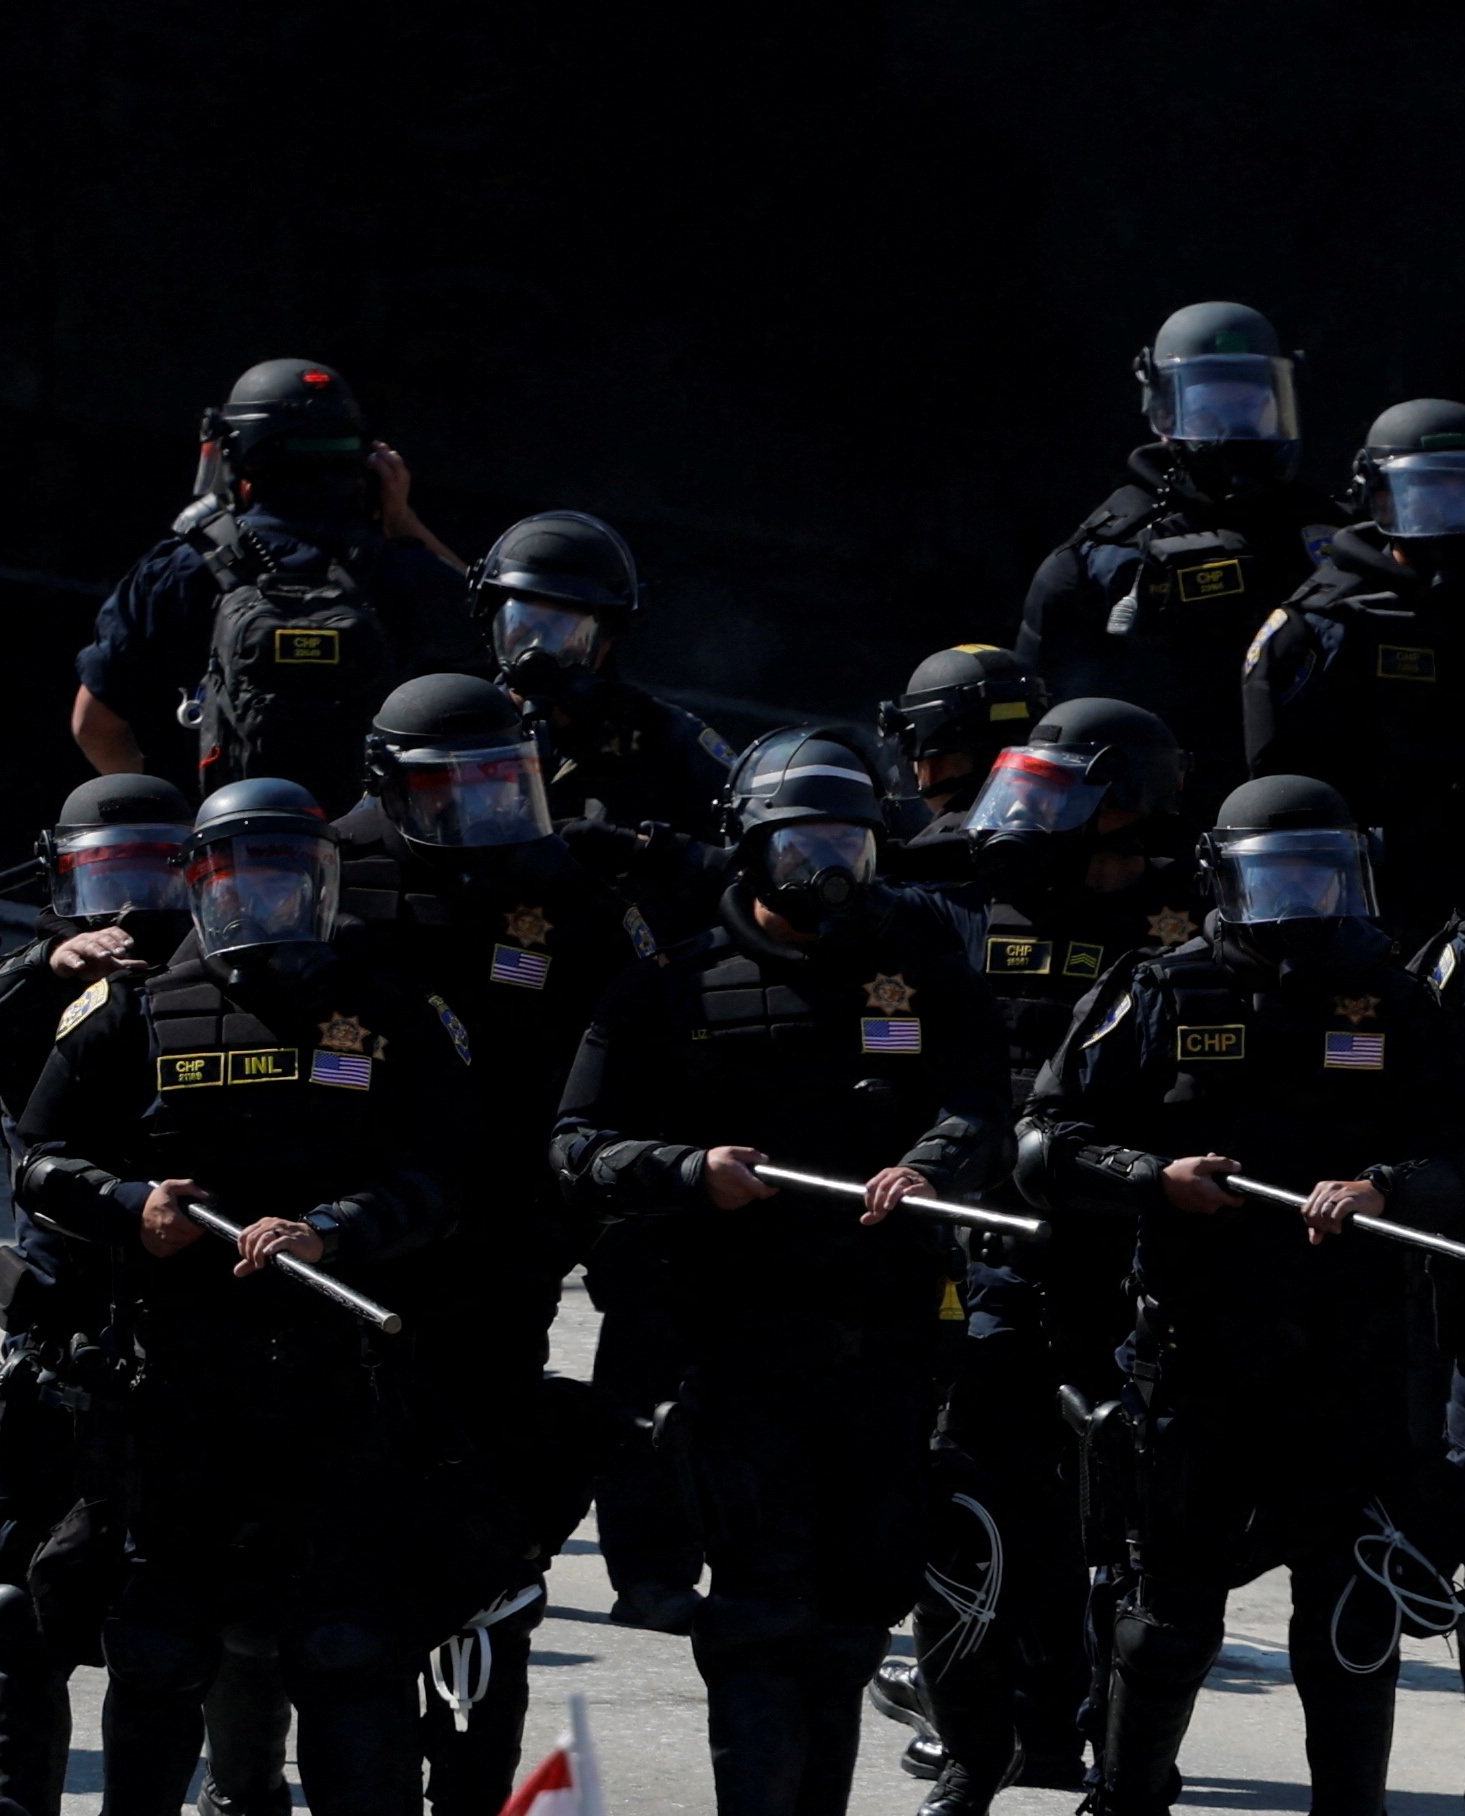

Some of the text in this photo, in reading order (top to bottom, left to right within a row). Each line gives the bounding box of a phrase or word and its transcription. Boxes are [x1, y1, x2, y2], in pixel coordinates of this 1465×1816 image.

[1006, 944, 1033, 957] CHP
[1186, 1033, 1237, 1053] CHP
[175, 1059, 205, 1073] CHP
[244, 1055, 283, 1075] INL
